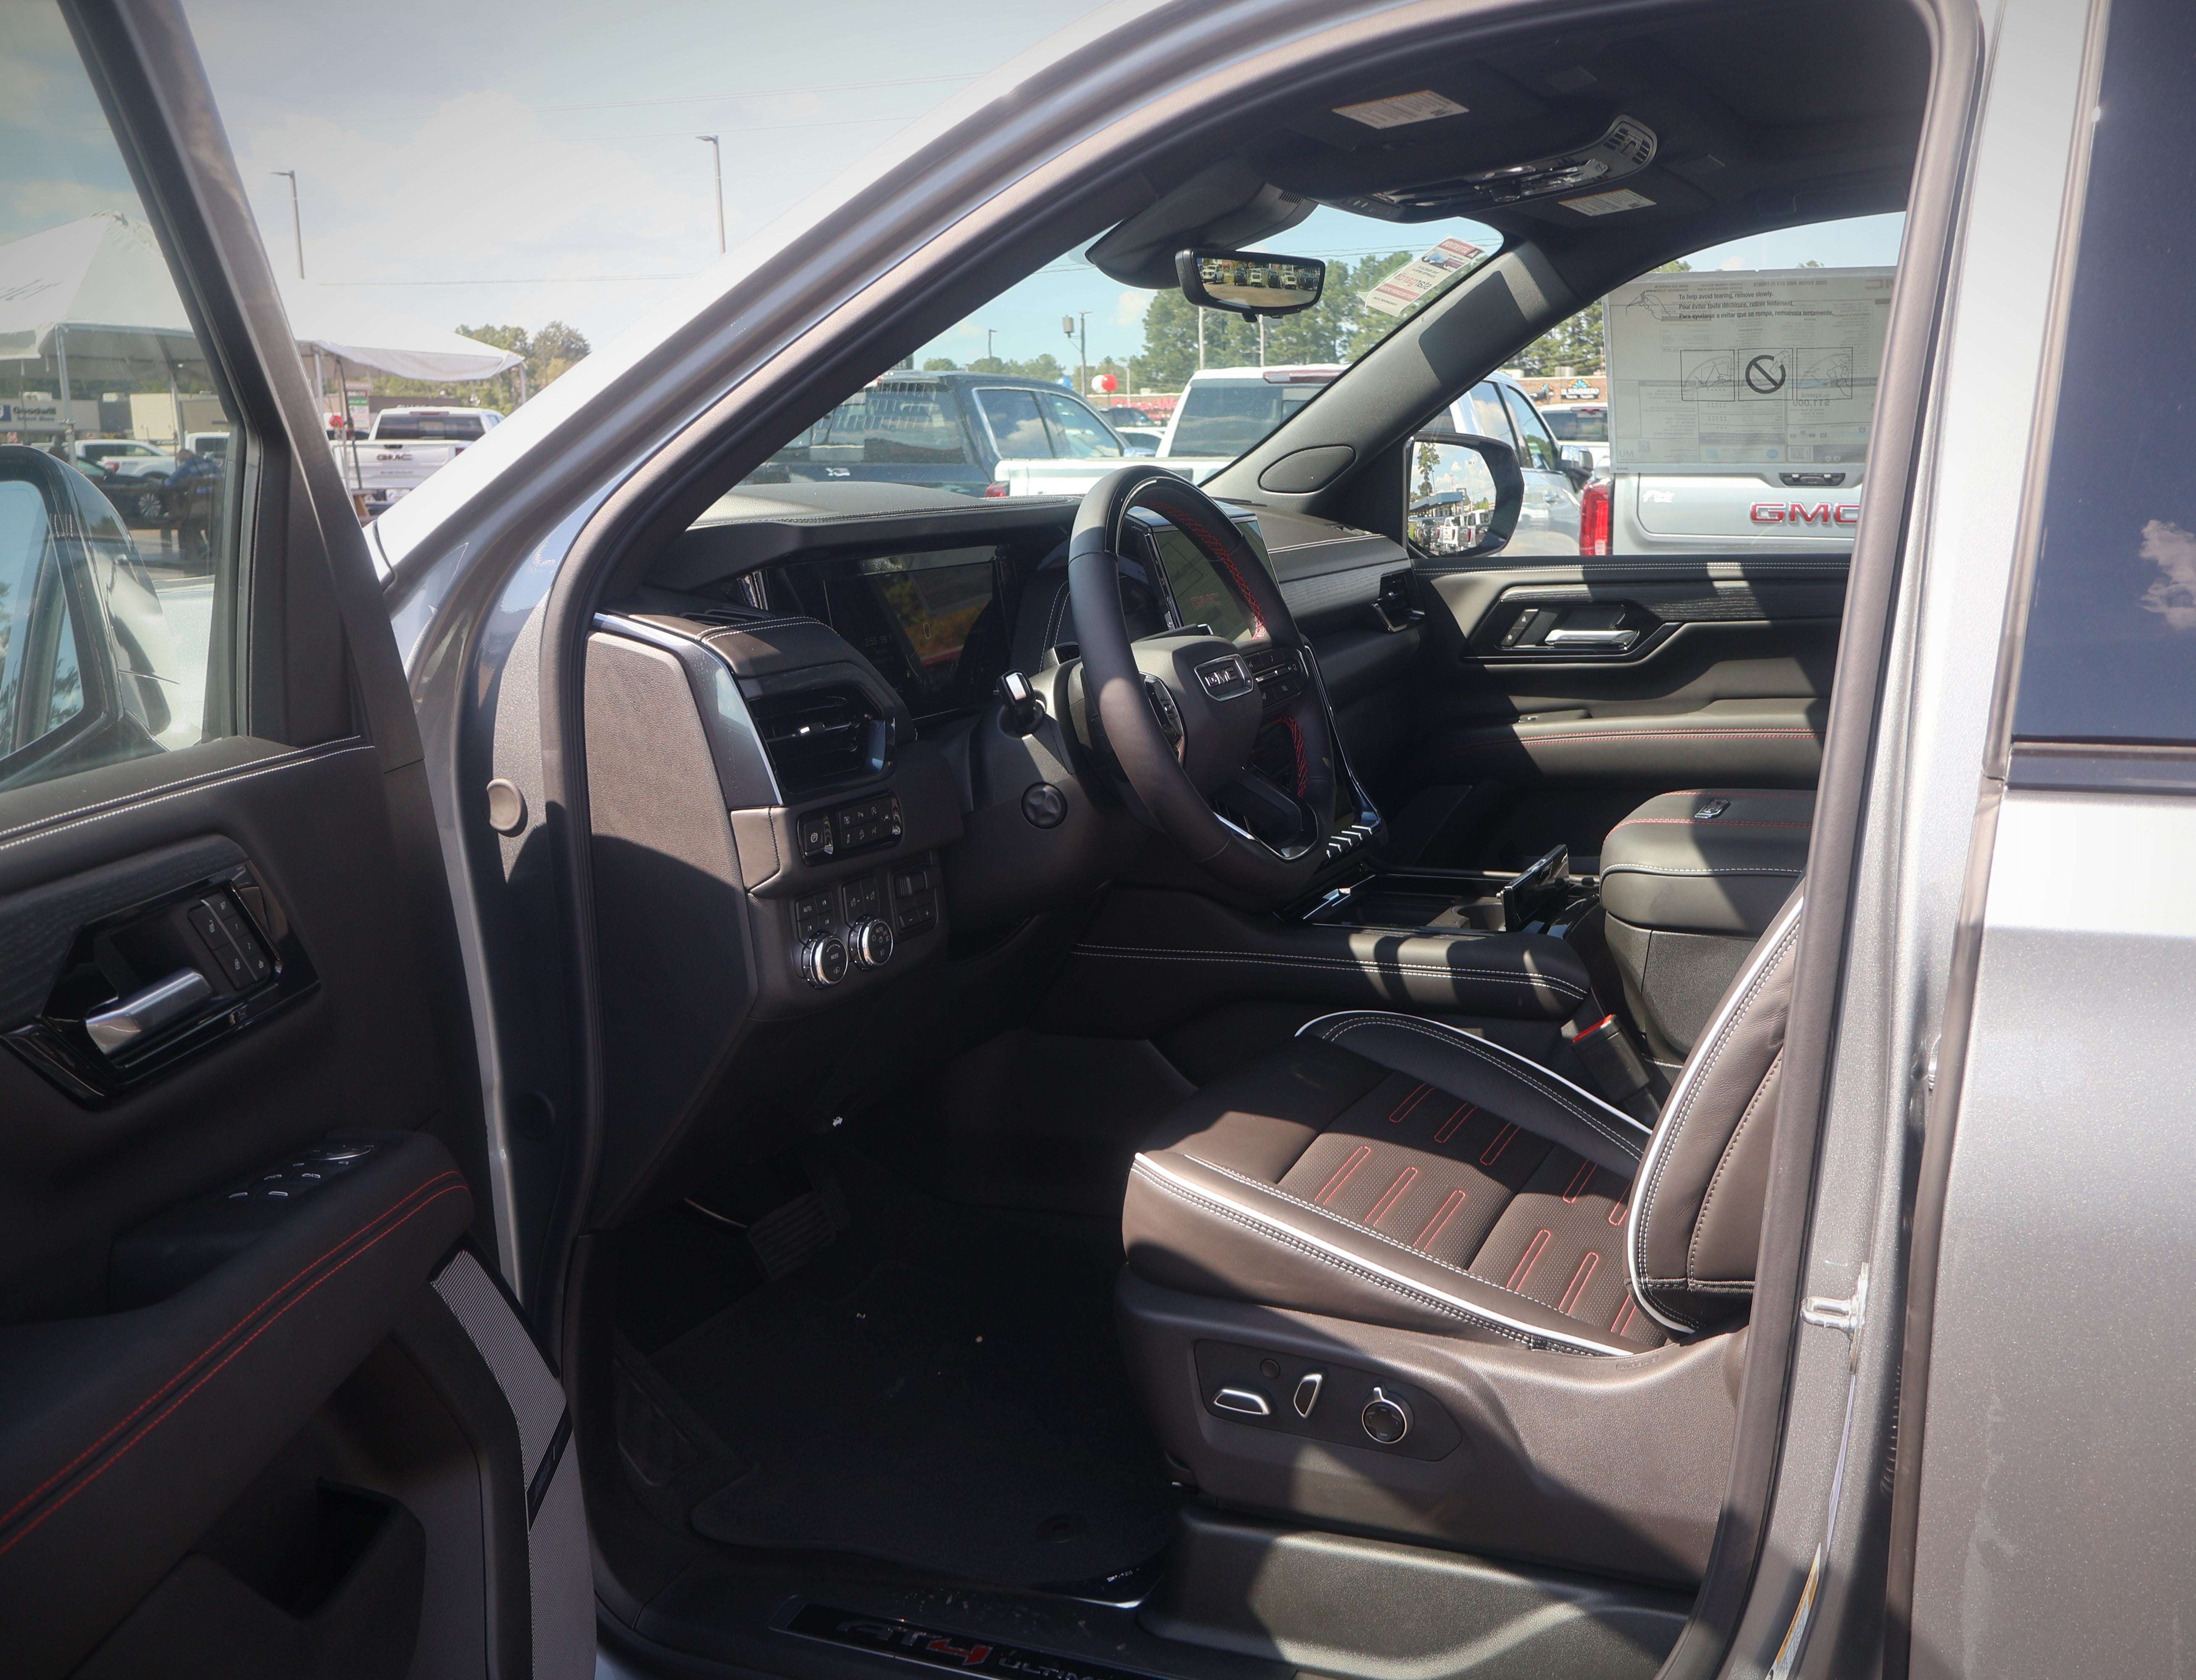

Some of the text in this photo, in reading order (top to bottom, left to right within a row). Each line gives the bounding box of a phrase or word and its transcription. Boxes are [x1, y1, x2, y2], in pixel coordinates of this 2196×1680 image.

[377, 452, 413, 461] GMC
[1750, 501, 1860, 524] GMC
[1190, 593, 1221, 610] GMC
[1205, 667, 1238, 687] GMC
[836, 1619, 992, 1666] AT4
